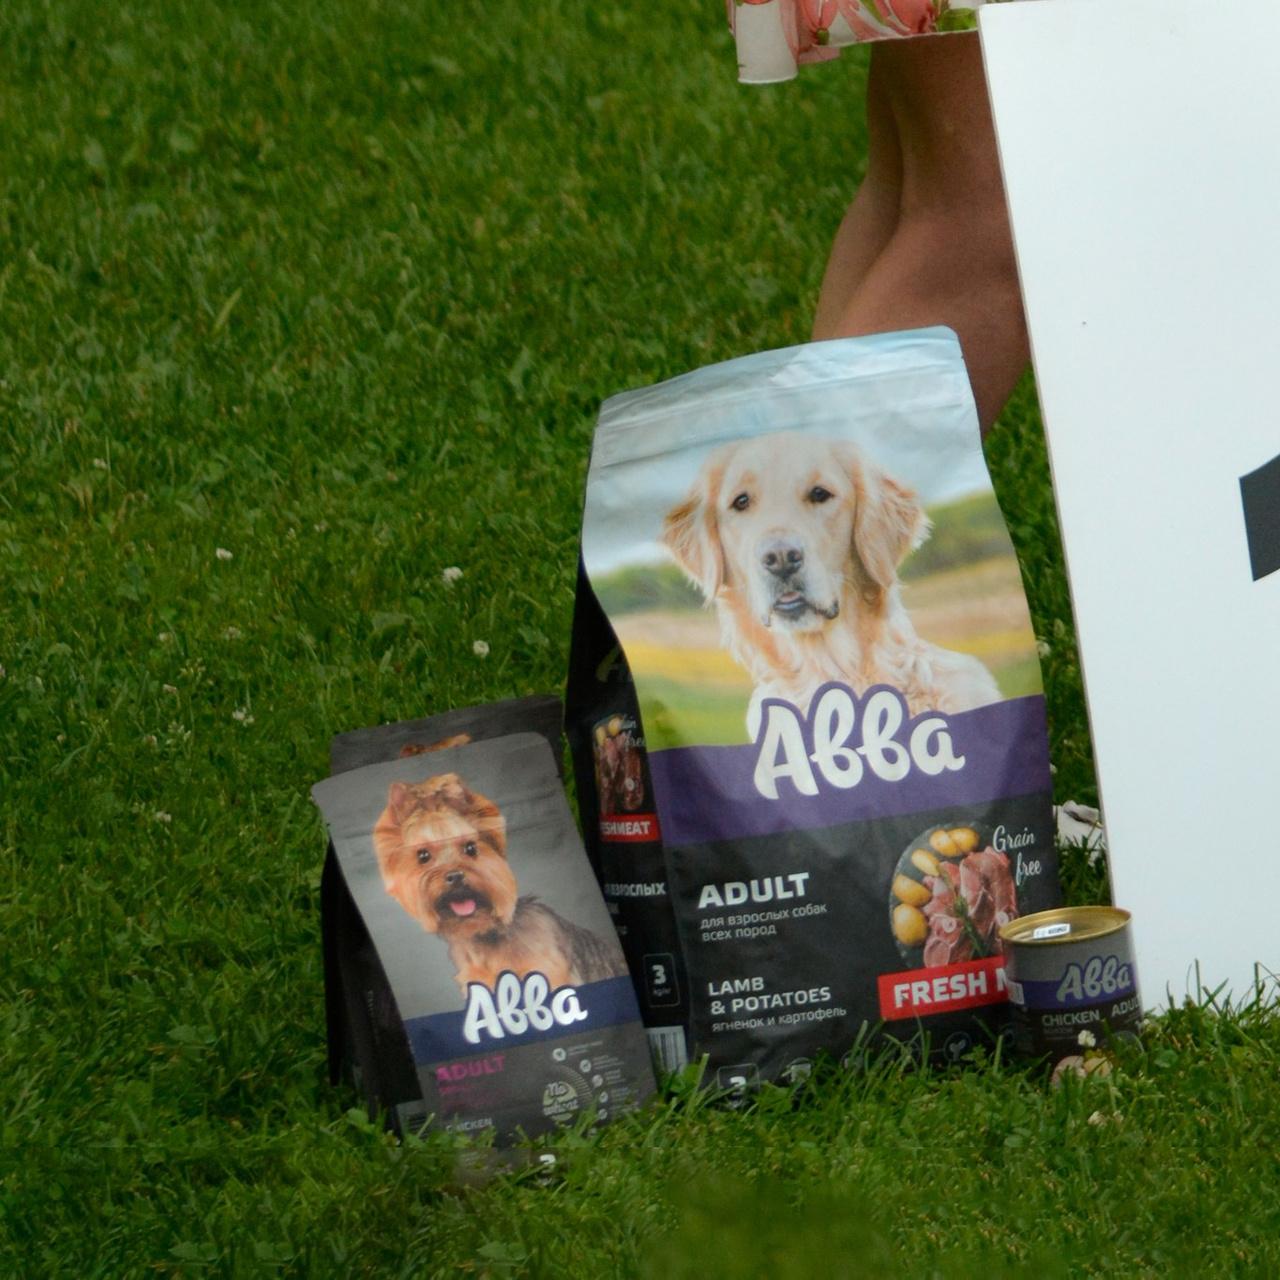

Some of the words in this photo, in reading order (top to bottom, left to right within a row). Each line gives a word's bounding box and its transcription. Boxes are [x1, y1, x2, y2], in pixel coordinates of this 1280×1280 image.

[992, 824, 1036, 853] Grain
[1015, 851, 1043, 886] free
[697, 871, 810, 909] ADULT
[700, 917, 724, 929] для
[727, 908, 790, 927] взрослых
[792, 903, 828, 917] собак
[702, 928, 732, 942] всех
[735, 924, 777, 939] пород
[651, 964, 667, 985] 3
[708, 976, 765, 996] LAMB
[710, 1000, 726, 1015] &
[731, 986, 831, 1013] POTATOES
[893, 969, 988, 1009] FRESH
[712, 1016, 765, 1032] ягненок
[766, 1016, 776, 1026] и
[778, 1006, 847, 1026] картофель
[1041, 1009, 1100, 1026] CHICKEN
[1111, 995, 1141, 1017] ADUL
[436, 1054, 506, 1082] ADULT
